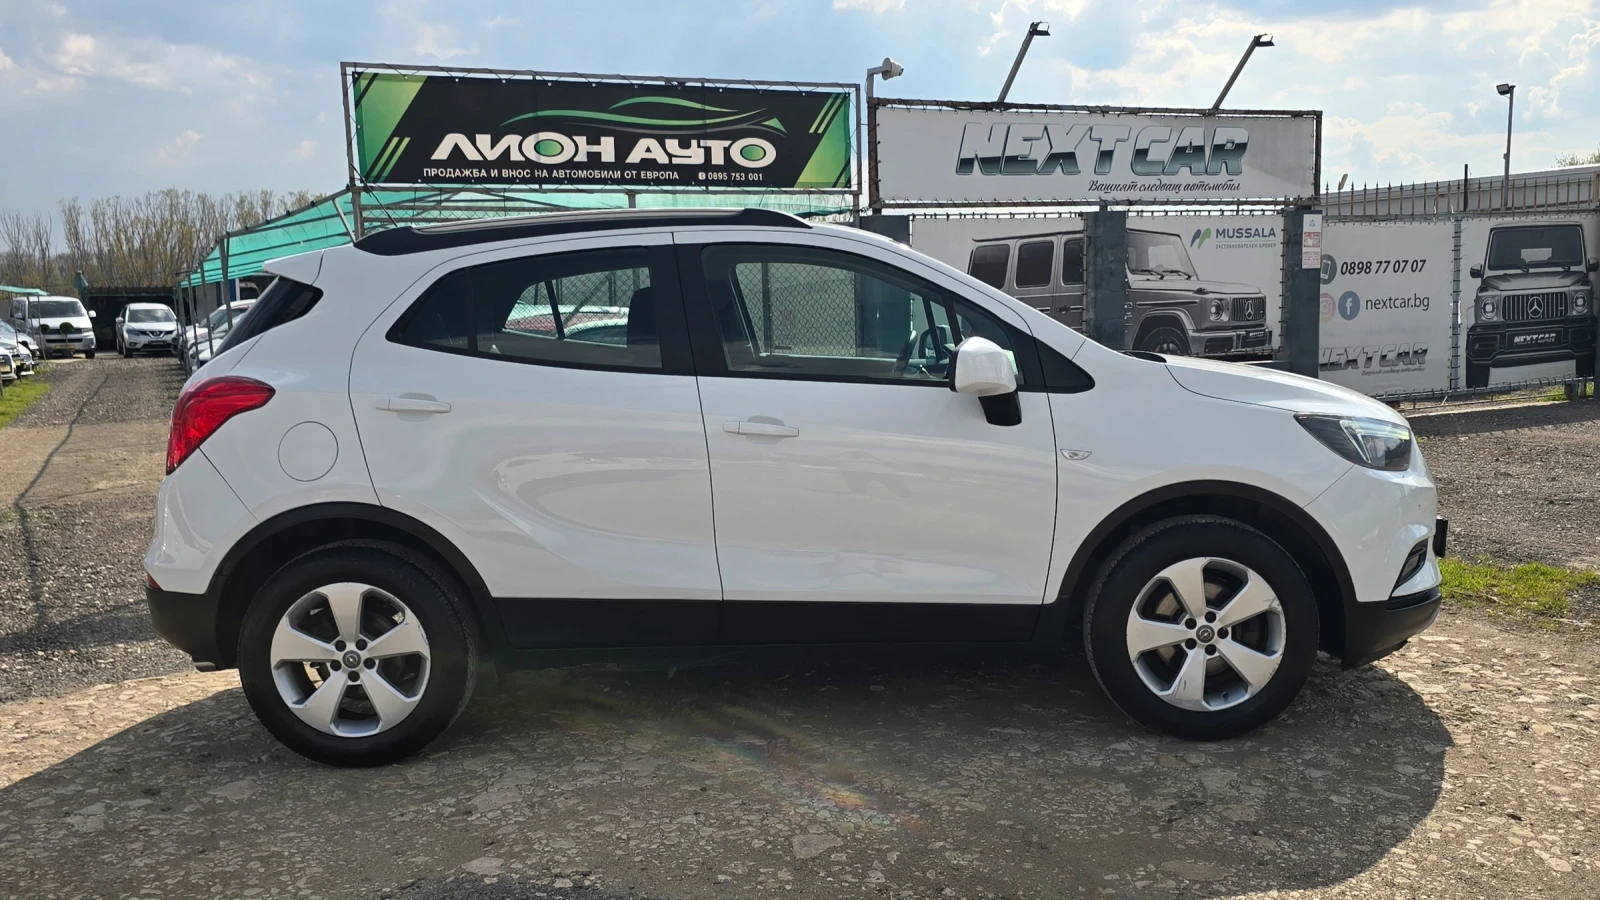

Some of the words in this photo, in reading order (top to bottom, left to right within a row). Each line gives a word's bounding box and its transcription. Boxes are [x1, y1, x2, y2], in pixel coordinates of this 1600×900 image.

[430, 131, 615, 165] ЛИОН
[625, 137, 776, 168] АУТО
[955, 121, 1250, 176] NEXTCAR
[423, 168, 487, 178] ПРОДАЖБА
[490, 168, 498, 178] И
[502, 169, 531, 178] ВНОС
[534, 169, 549, 178] НА
[552, 169, 621, 179] АВТОМОБИЛИ
[624, 170, 637, 179] ОТ
[640, 171, 680, 180] ЕВРОПА
[707, 172, 728, 181] 0895
[730, 172, 745, 181] 753
[748, 173, 763, 181] 001
[1088, 180, 1138, 194] Вашият
[1138, 178, 1182, 194] следващ
[1183, 179, 1241, 191] автомобил
[1216, 227, 1276, 239] MUSSALA
[1340, 261, 1372, 275] 0898
[1374, 260, 1391, 274] 77
[1392, 260, 1409, 273] 07
[1410, 259, 1427, 273] 07
[1365, 293, 1430, 311] nextcar.bg
